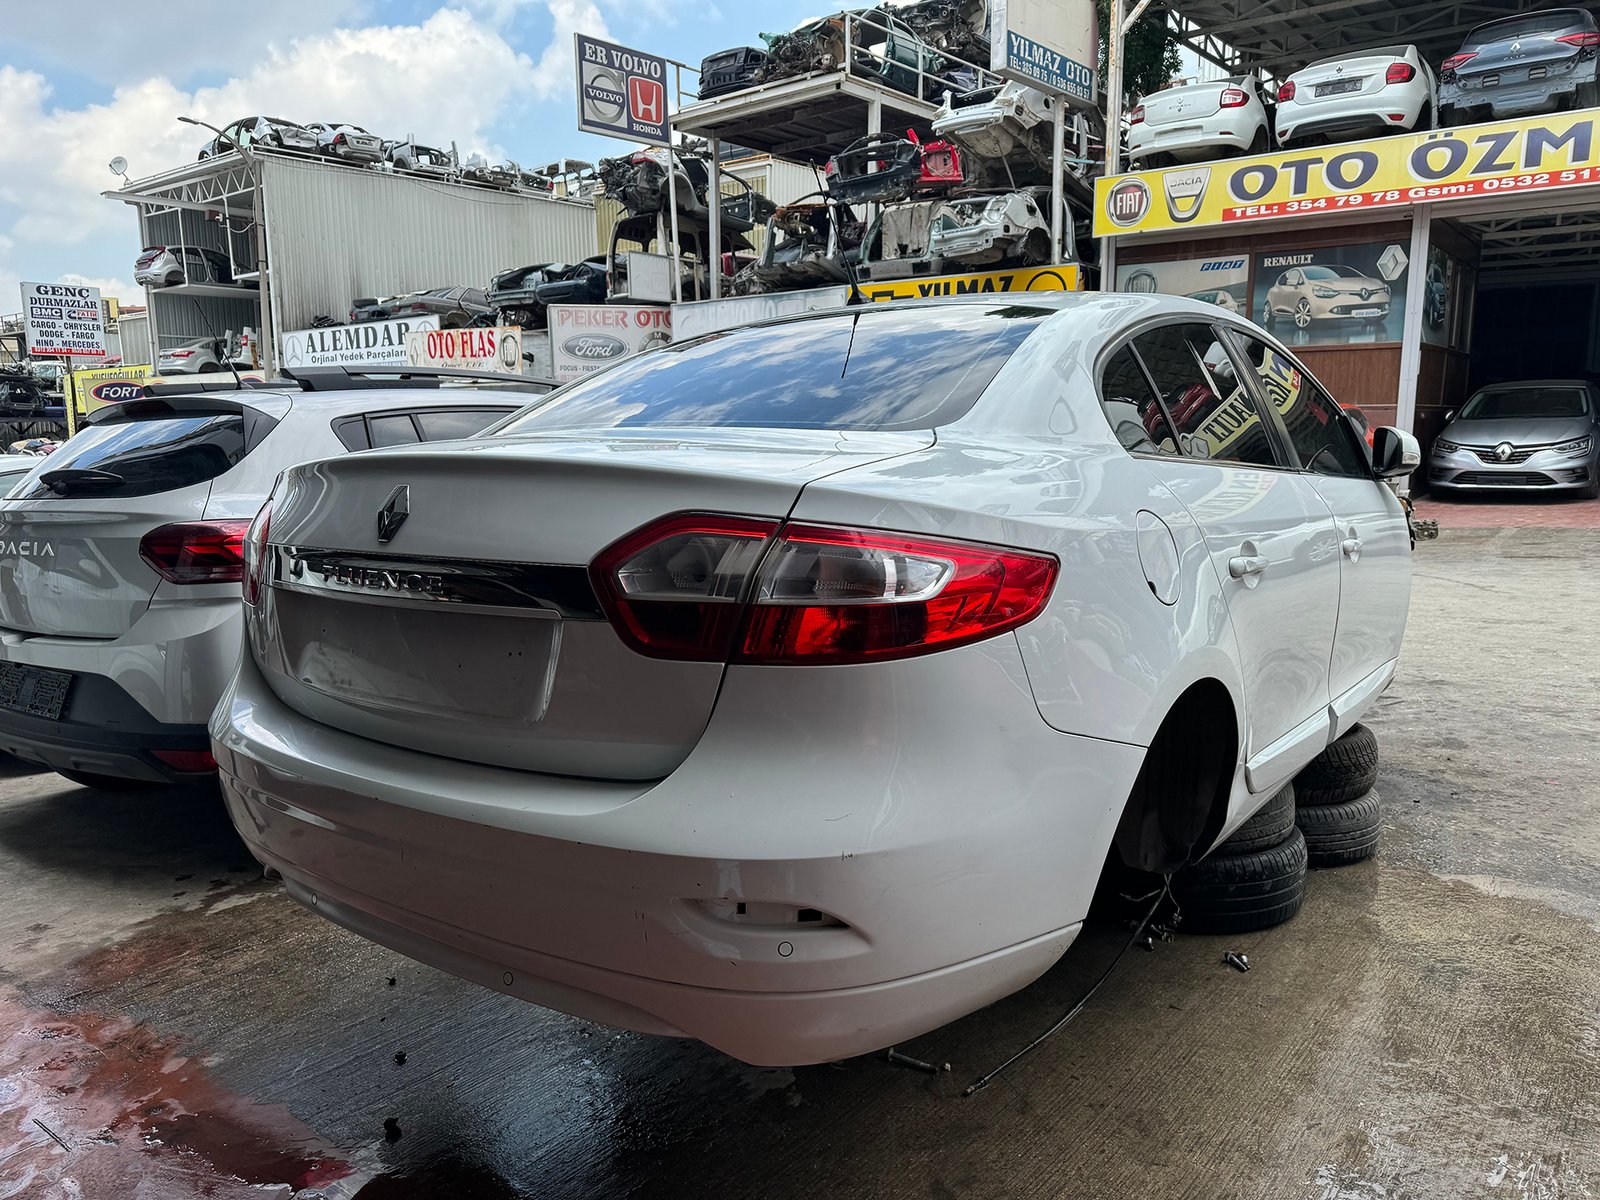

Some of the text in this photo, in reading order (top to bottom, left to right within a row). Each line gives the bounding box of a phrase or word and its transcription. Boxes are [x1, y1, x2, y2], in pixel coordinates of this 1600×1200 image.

[584, 42, 661, 78] ER VOLVO
[1010, 33, 1090, 86] YILMAZ OTO
[1010, 55, 1021, 69] TEL:
[587, 87, 623, 103] VOLVO
[633, 123, 662, 136] HONDA
[1170, 176, 1202, 188] DACIA
[1228, 151, 1379, 203] OTO
[1116, 191, 1142, 215] FIAT
[1232, 205, 1278, 217] TEL:
[1286, 199, 1327, 211] 354
[1335, 195, 1363, 206] 79
[1370, 190, 1400, 202] 78
[1408, 183, 1474, 197] Gsm:
[1482, 174, 1550, 190] 0532
[1202, 260, 1243, 271] FIAT
[1263, 254, 1313, 268] RENAULT
[36, 285, 90, 300] GENÇ
[29, 296, 98, 310] DURMAZLAR
[33, 307, 61, 317] BMC
[557, 309, 628, 329] PEKER
[31, 320, 56, 329] CARGO
[63, 322, 102, 331] CHRYSLER
[39, 330, 65, 338] DODGE
[72, 331, 95, 340] FARGO
[305, 321, 410, 354] ALEMDAR
[36, 339, 54, 347] HINO
[61, 340, 100, 349] MERCEDES
[427, 332, 455, 359] OTO
[575, 337, 613, 357] Ford
[311, 348, 407, 365] Orjinal Yedek Parçaları
[101, 386, 140, 398] FORT
[322, 564, 444, 594] FLUENCE
